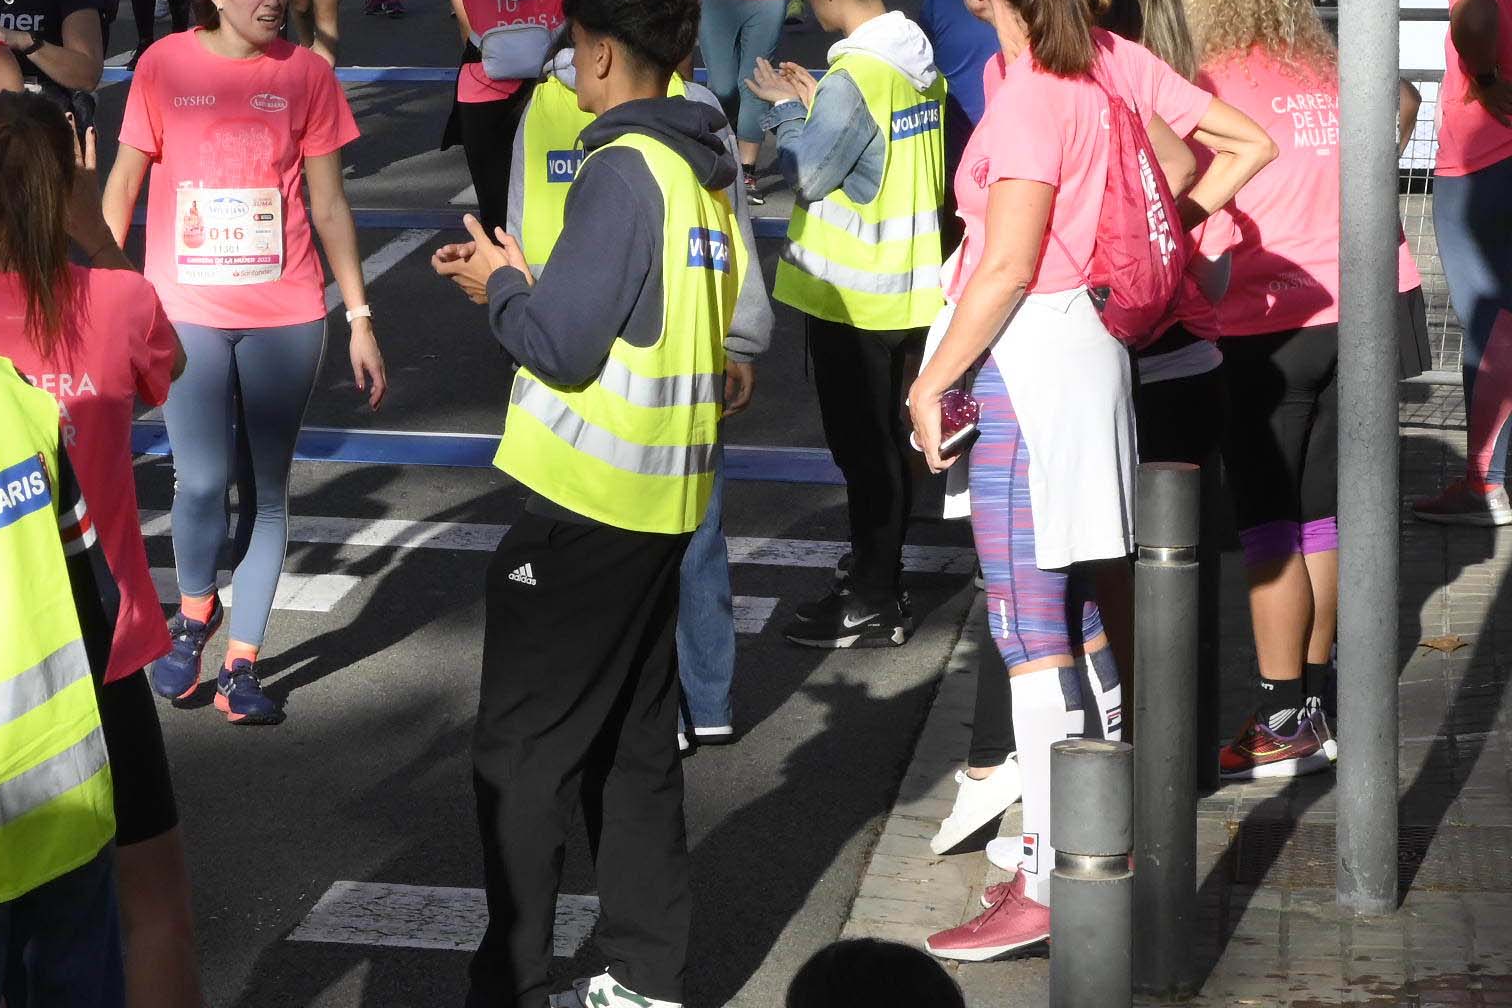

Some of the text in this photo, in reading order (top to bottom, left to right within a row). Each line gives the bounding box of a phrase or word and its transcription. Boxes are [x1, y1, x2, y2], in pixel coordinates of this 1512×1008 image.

[174, 95, 216, 108] OYSHO
[1291, 110, 1339, 130] DE LA
[209, 227, 245, 241] 016
[508, 571, 538, 587] adidas
